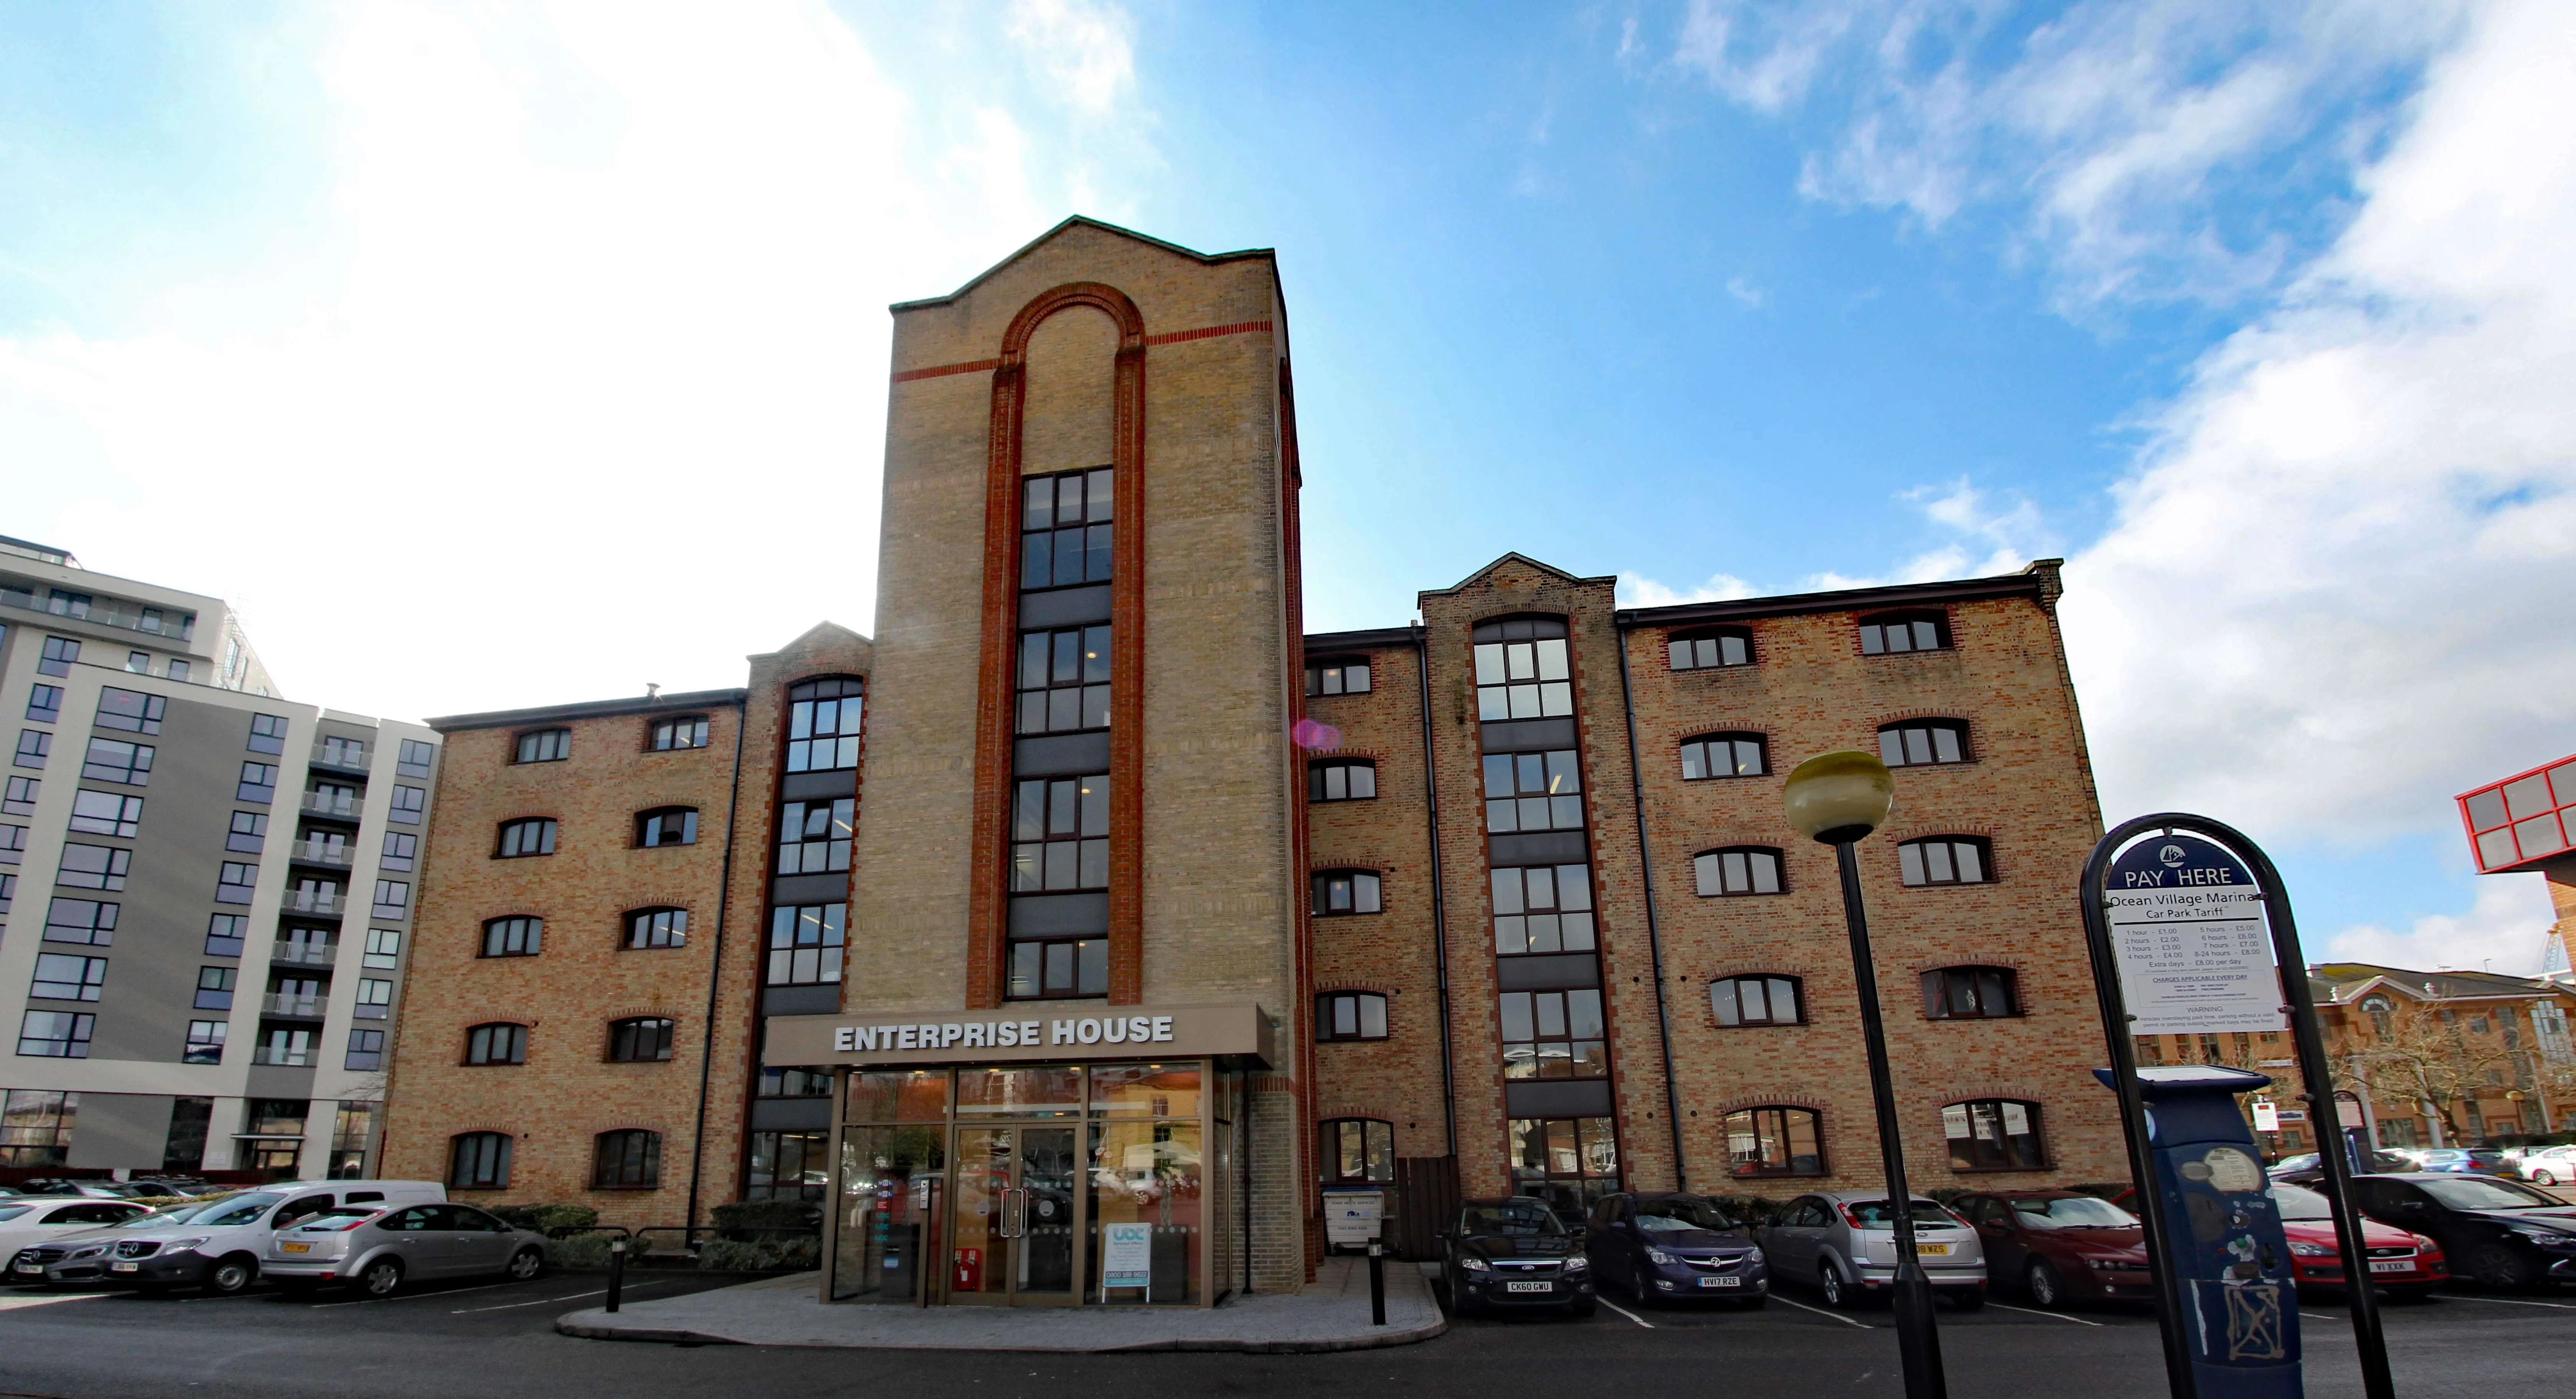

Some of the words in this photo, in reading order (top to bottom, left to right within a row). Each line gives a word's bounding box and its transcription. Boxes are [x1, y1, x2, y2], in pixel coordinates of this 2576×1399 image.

[2125, 870, 2164, 887] PAY
[2178, 868, 2232, 885] HERE
[2110, 897, 2152, 907] Ocean
[2156, 894, 2202, 906] Village
[2207, 892, 2254, 903] Marina
[2146, 910, 2163, 918] Car
[2168, 908, 2192, 918] Park
[2195, 907, 2224, 917] Tariff
[834, 1020, 1041, 1051] ENTERPRISE
[1052, 1016, 1174, 1045] HOUSE
